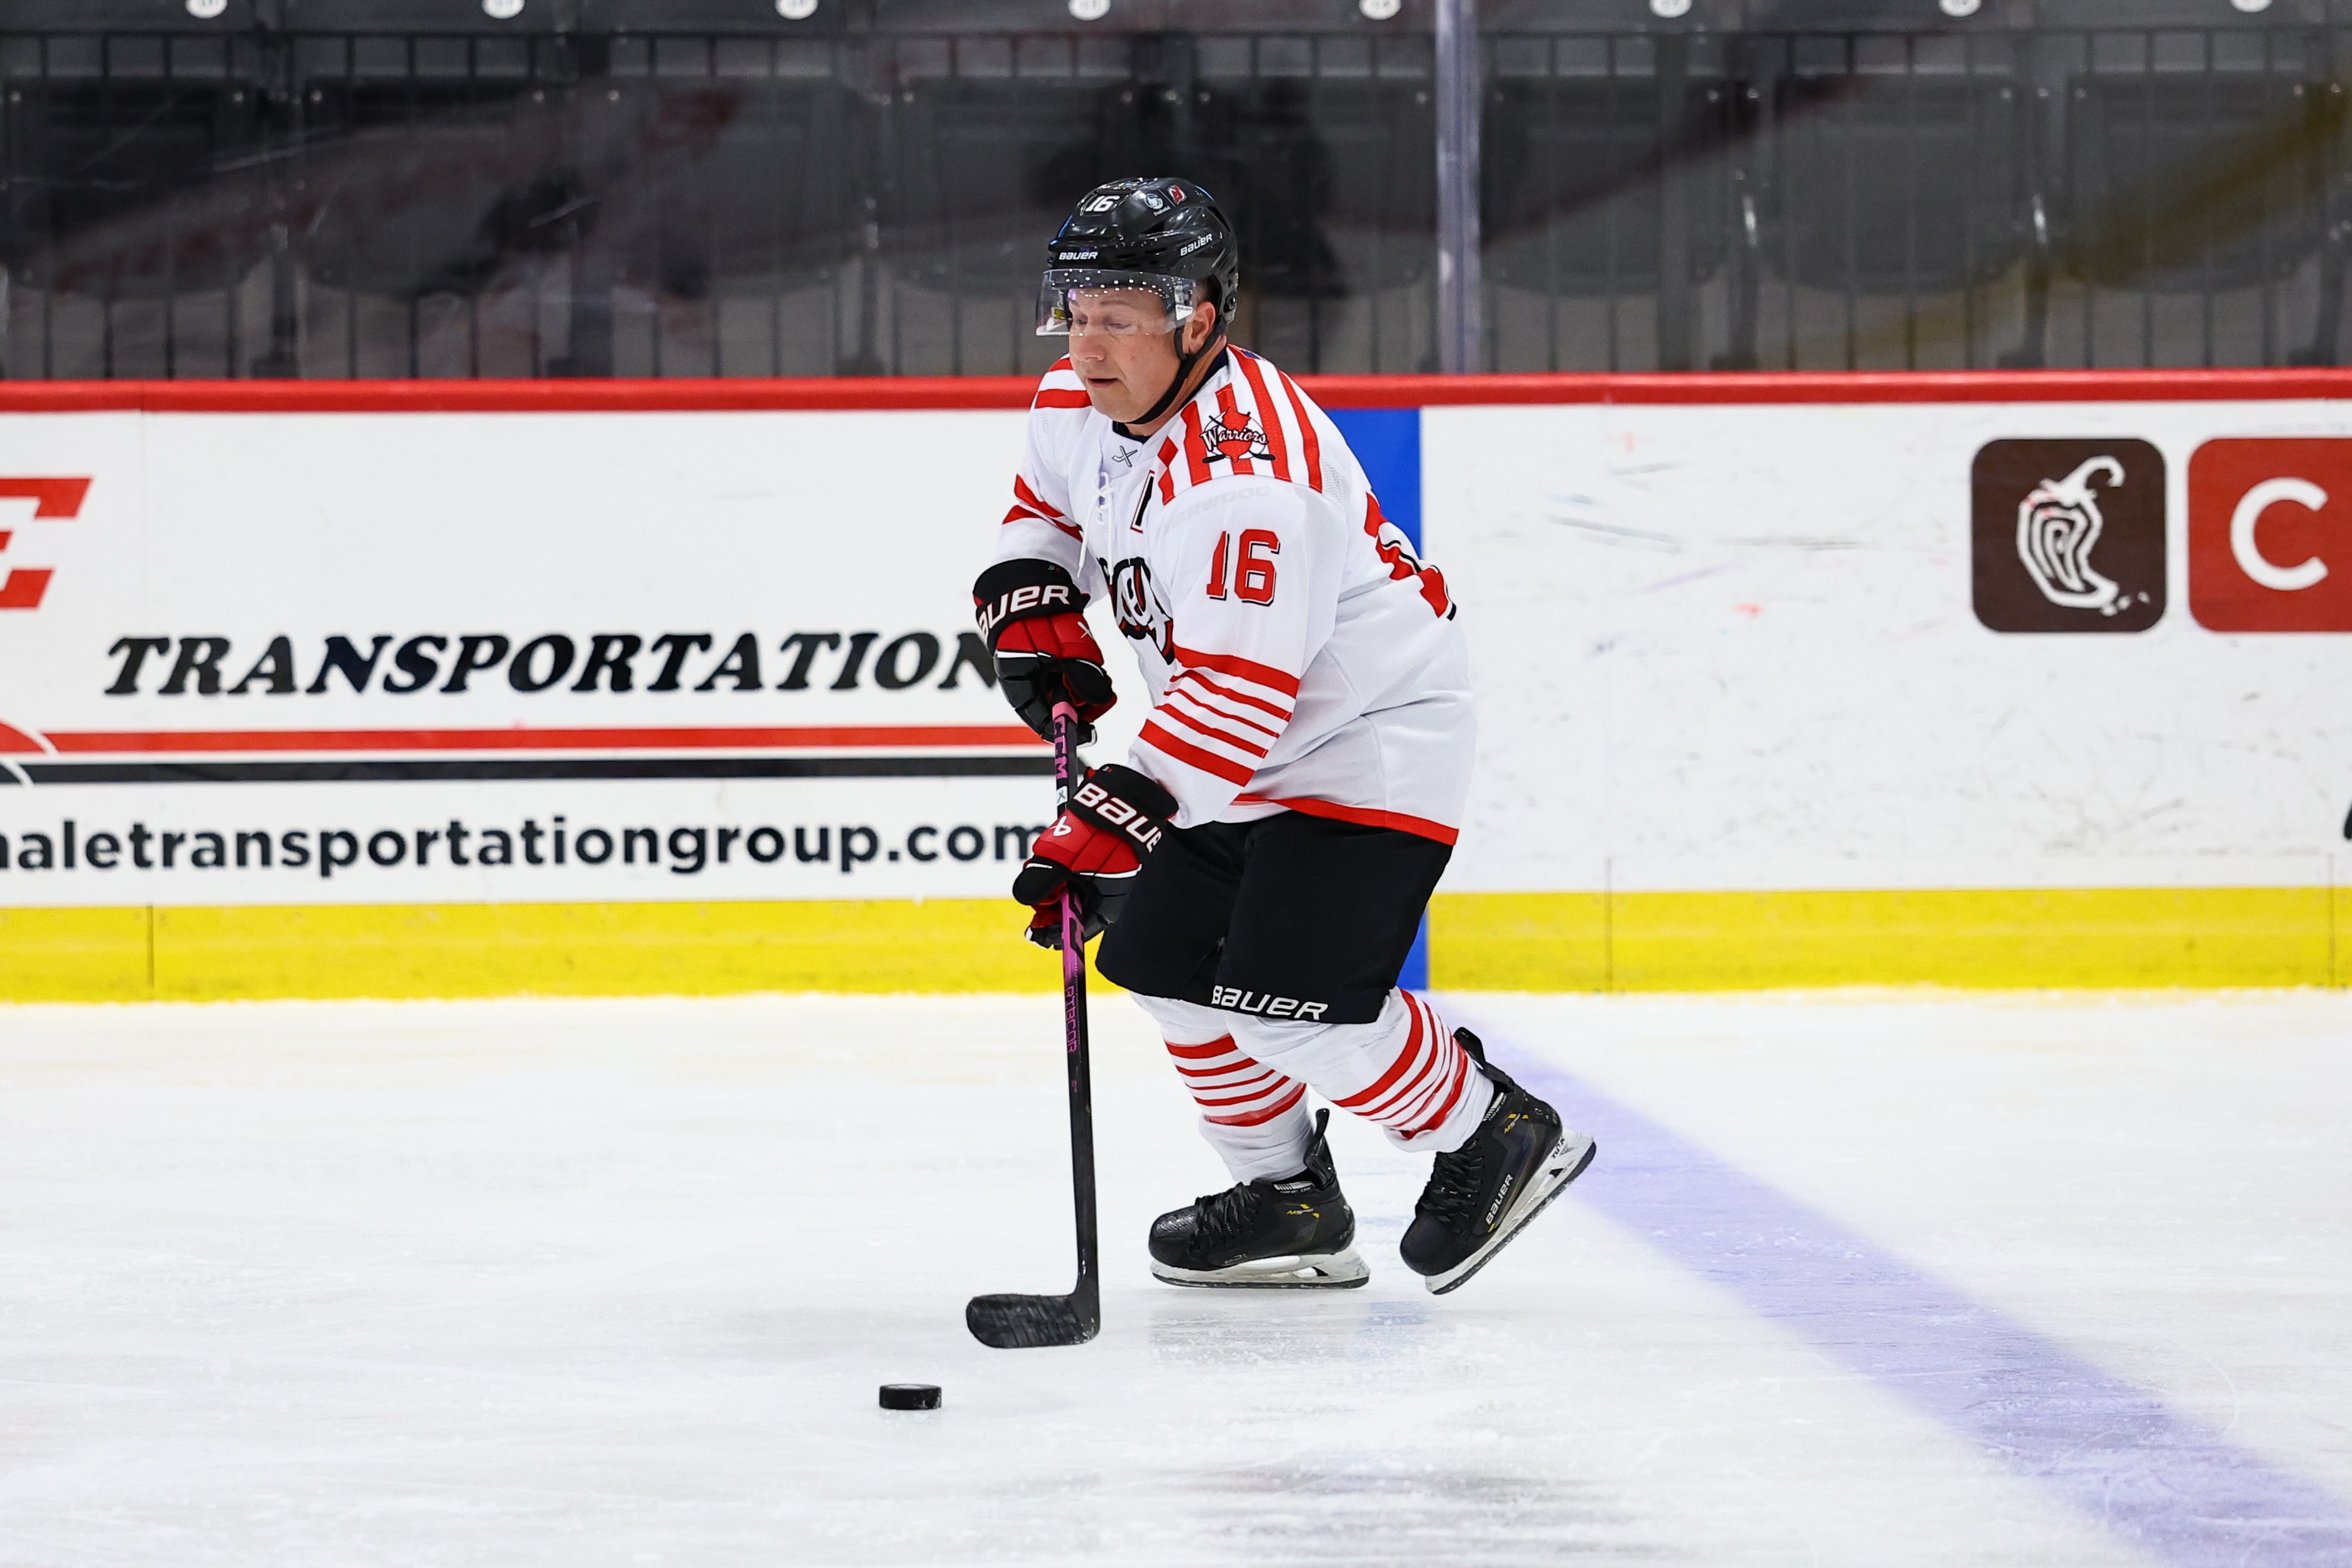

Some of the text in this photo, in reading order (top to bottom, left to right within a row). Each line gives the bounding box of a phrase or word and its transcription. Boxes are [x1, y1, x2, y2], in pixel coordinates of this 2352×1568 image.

[1085, 195, 1121, 212] 16
[1059, 251, 1098, 261] BAUER
[1180, 232, 1214, 257] BAUER
[1199, 425, 1270, 452] Warriors
[2230, 476, 2328, 591] C
[1207, 528, 1280, 607] 16
[978, 584, 1070, 646] AUER
[104, 631, 998, 696] TRANSPORTATION
[1054, 715, 1068, 780] CCM
[0, 815, 1048, 879] aletransportationgroup.com
[1073, 782, 1162, 853] BAUE
[1211, 984, 1329, 1021] BAUER
[1485, 1173, 1513, 1225] BAUER
